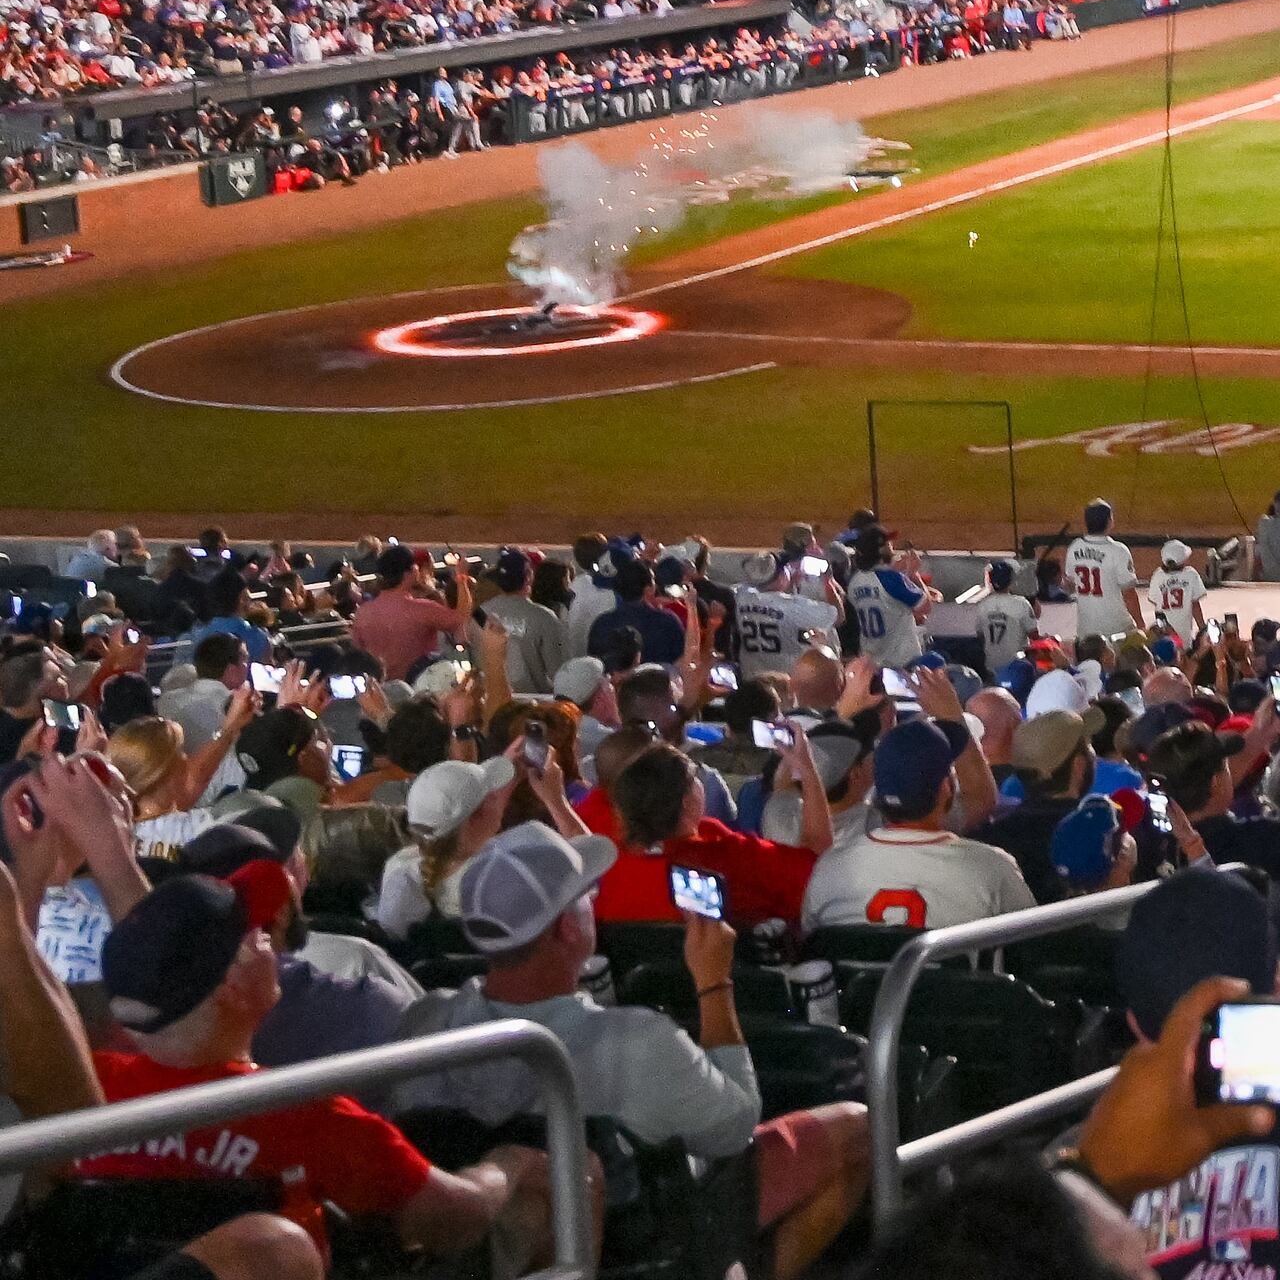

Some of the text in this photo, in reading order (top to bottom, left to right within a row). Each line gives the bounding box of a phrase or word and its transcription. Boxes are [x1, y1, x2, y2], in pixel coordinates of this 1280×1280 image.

[1074, 565, 1104, 597] 31
[1161, 587, 1185, 610] 13
[742, 620, 782, 654] 25
[858, 606, 886, 639] 10
[195, 1129, 261, 1176] JR
